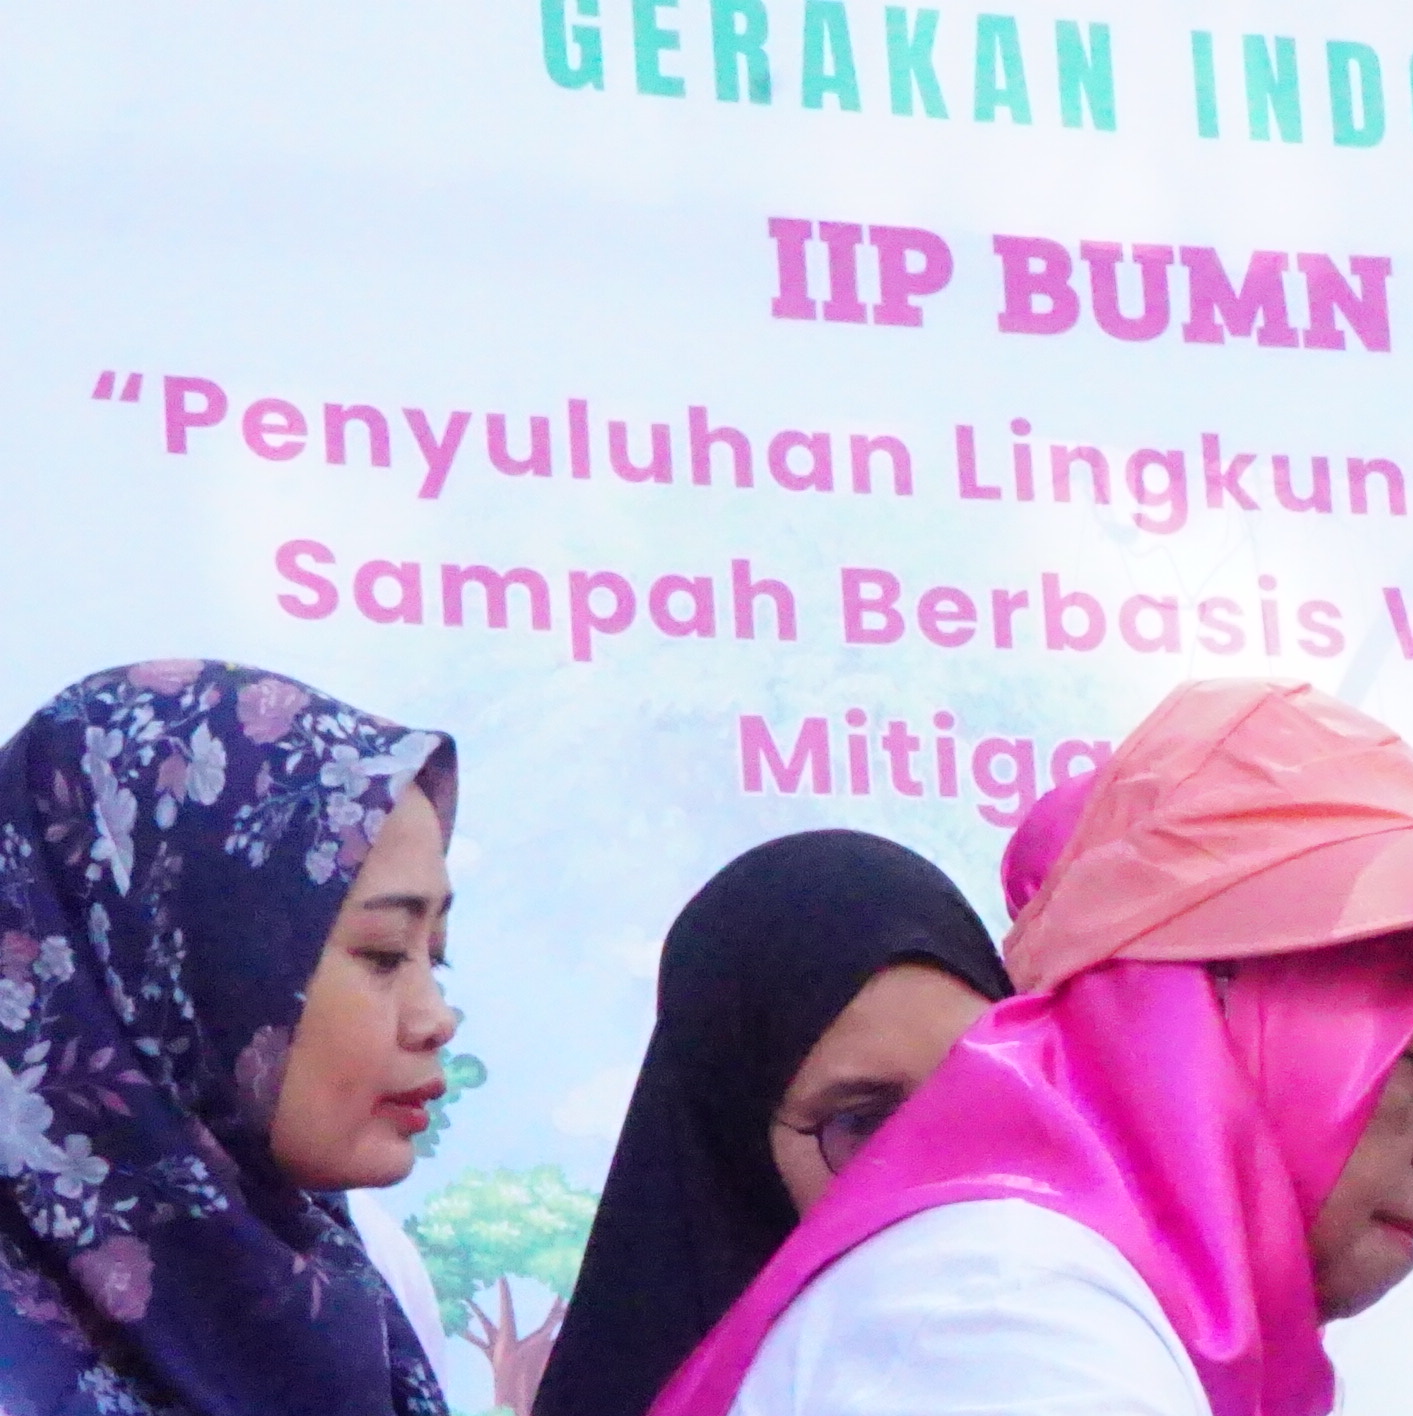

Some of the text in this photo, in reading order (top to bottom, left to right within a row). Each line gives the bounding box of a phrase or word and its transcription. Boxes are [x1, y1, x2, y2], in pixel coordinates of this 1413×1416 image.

[539, 0, 1117, 132] GERAKAN
[767, 217, 954, 328] IIP
[992, 233, 1393, 354] BUMN
[91, 370, 915, 501] “Penyuluhan
[274, 538, 798, 664] Sampah
[841, 564, 1347, 661] Berbasis
[739, 707, 1114, 829] Mitiga
